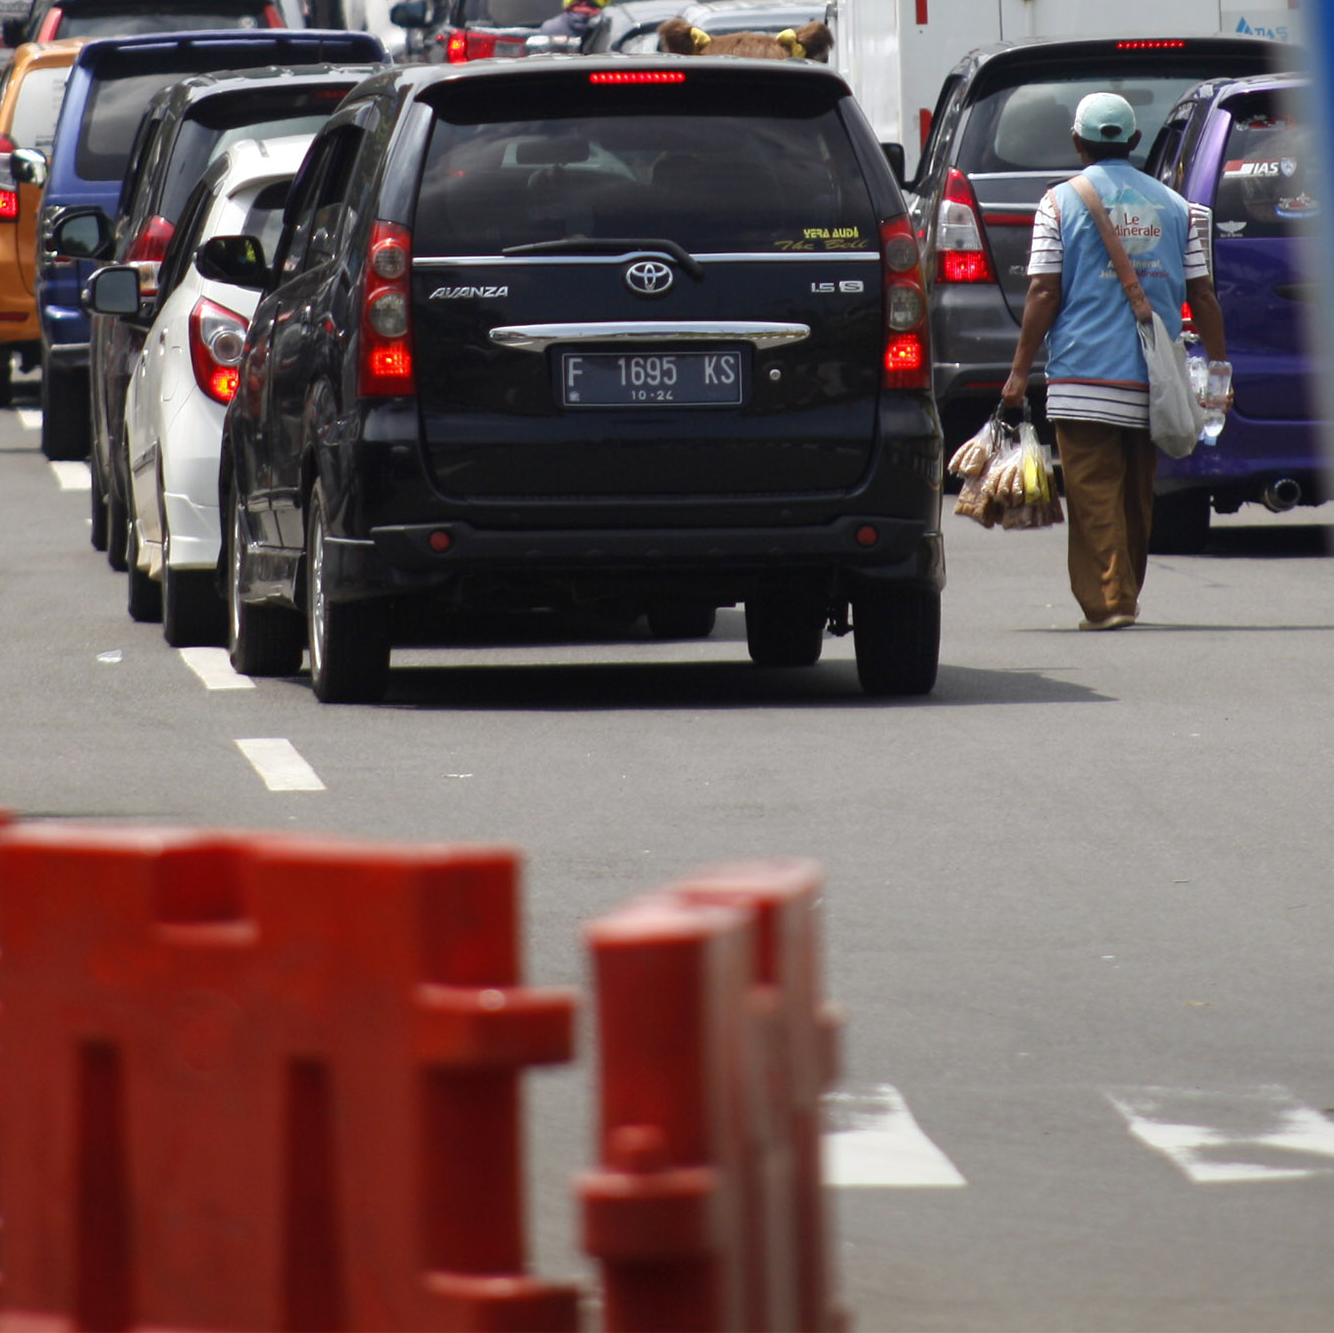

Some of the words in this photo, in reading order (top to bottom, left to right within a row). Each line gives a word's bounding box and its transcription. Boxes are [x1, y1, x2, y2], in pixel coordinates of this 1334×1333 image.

[1124, 213, 1140, 225] Le
[774, 240, 814, 250] The
[429, 286, 509, 299] AVANZA
[568, 358, 583, 386] F
[618, 356, 677, 386] 1695
[704, 355, 736, 385] KS
